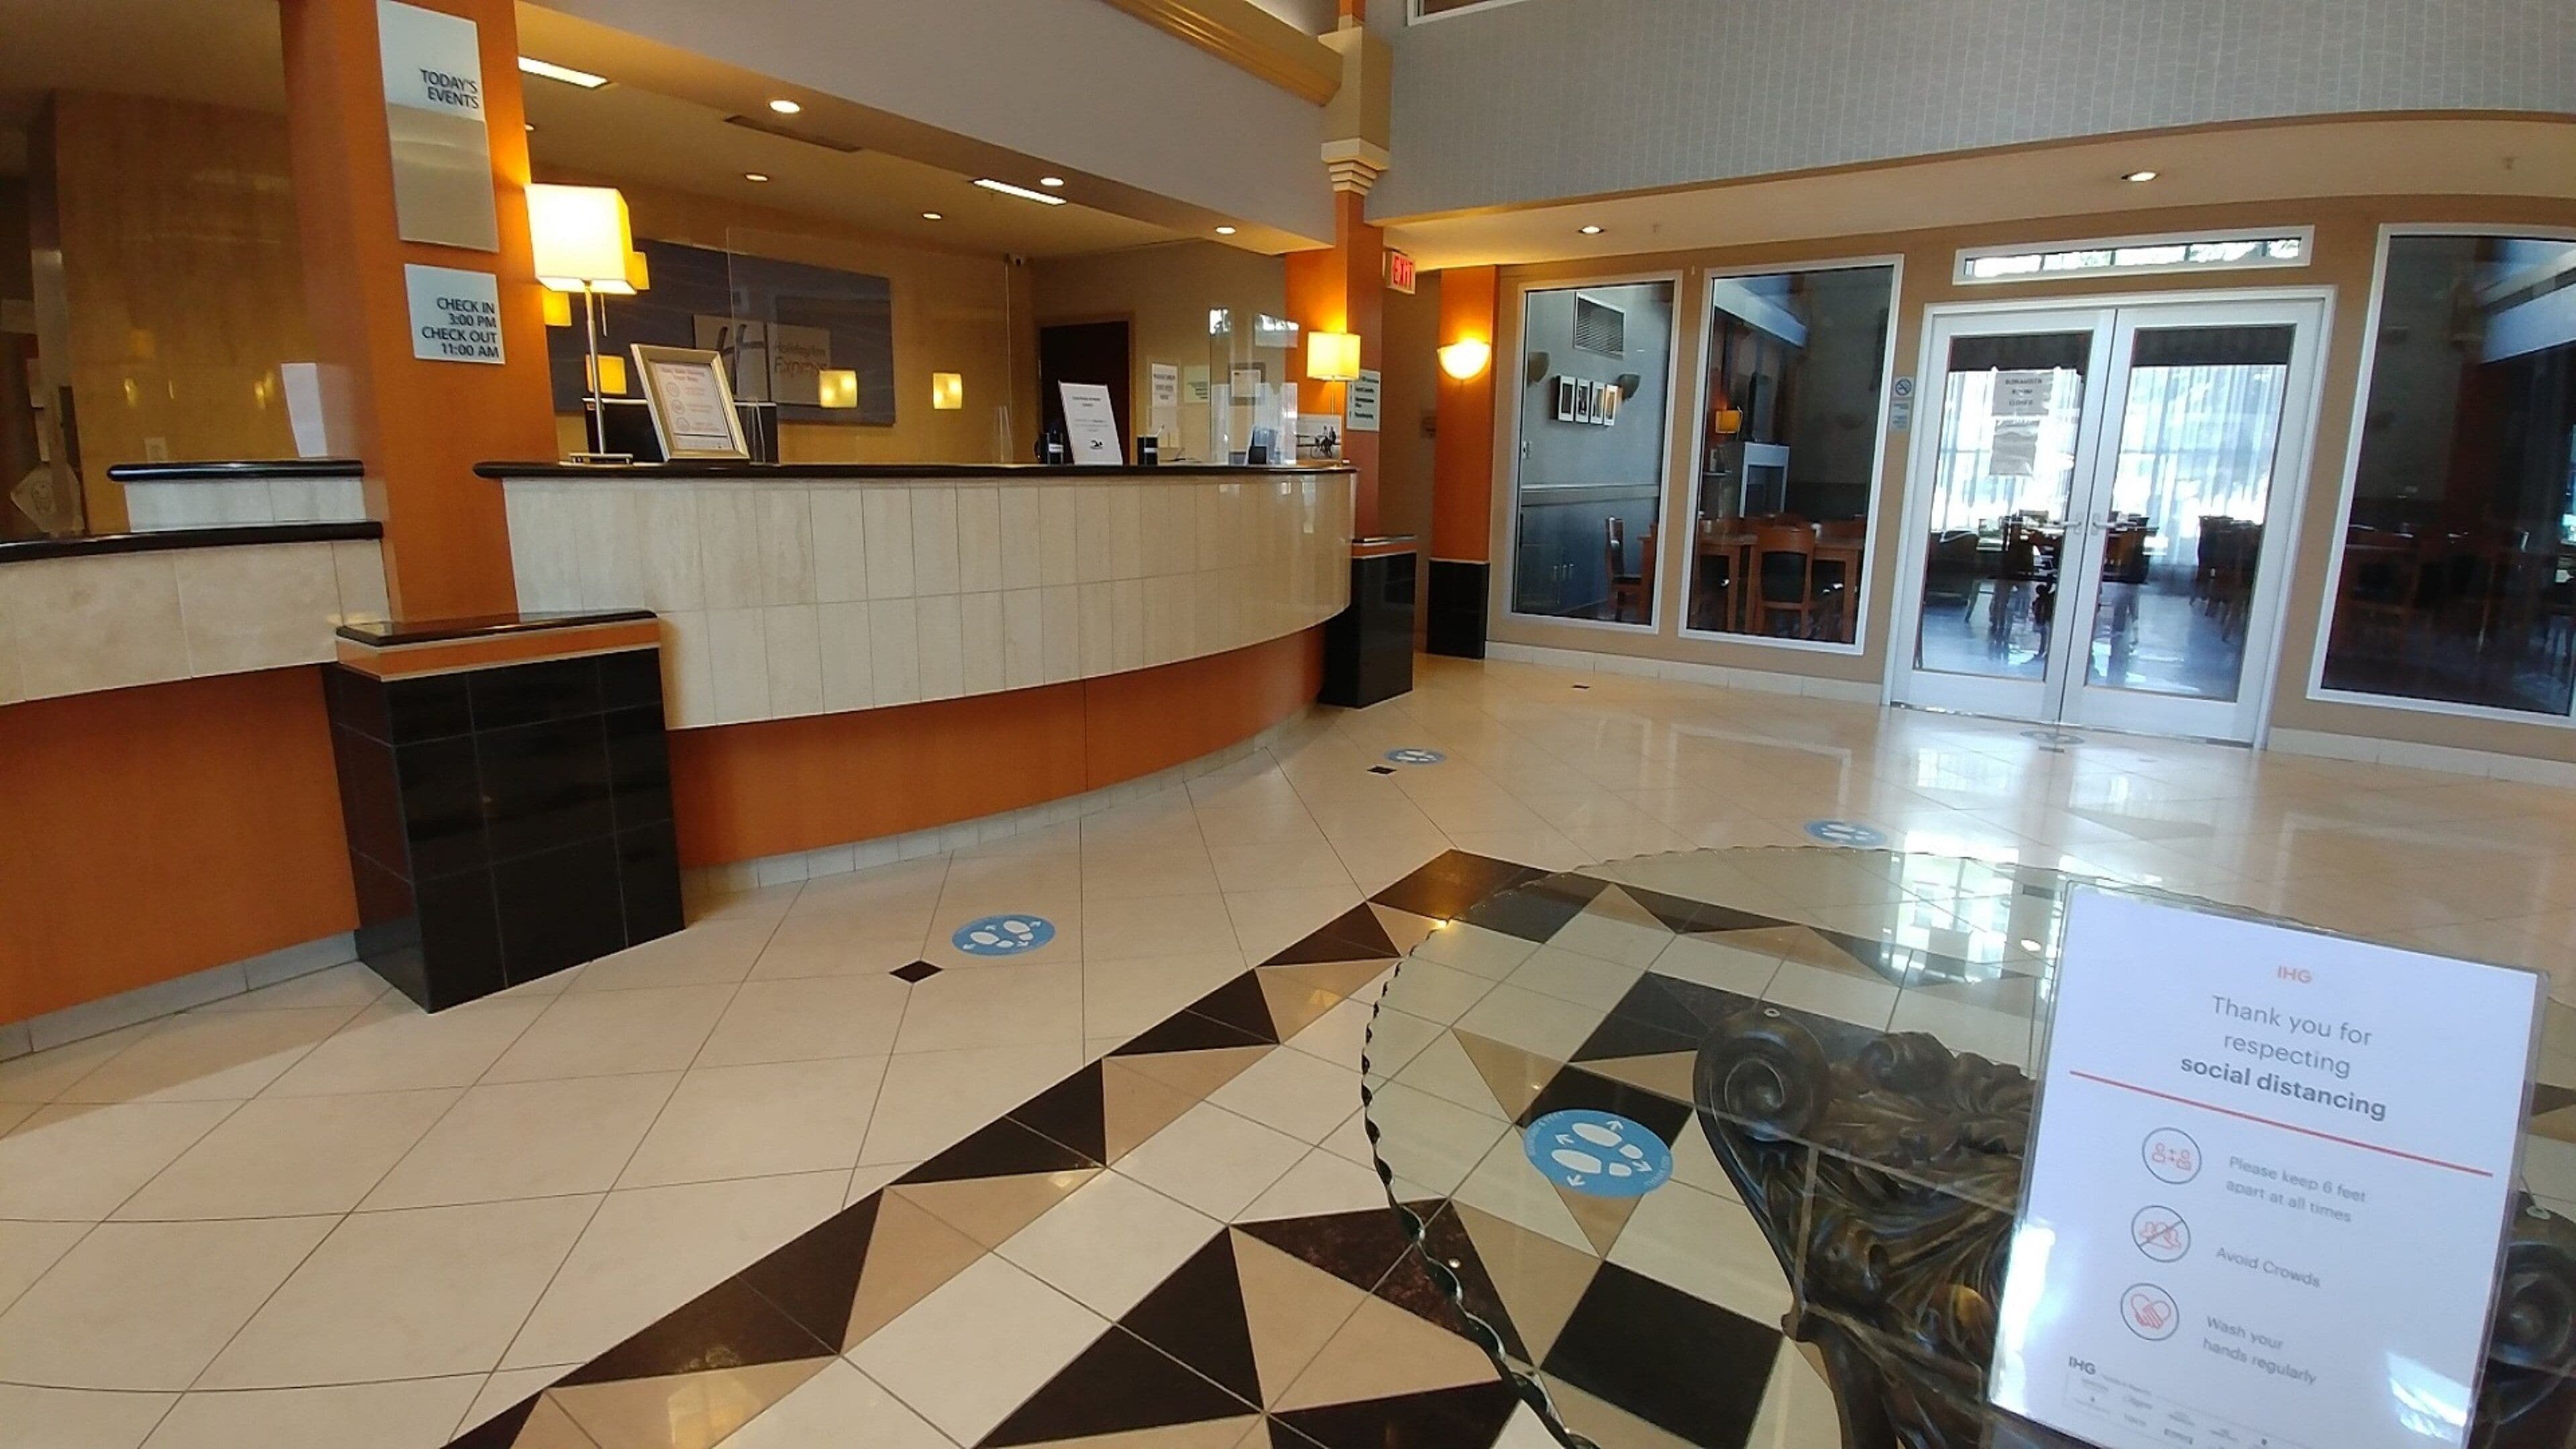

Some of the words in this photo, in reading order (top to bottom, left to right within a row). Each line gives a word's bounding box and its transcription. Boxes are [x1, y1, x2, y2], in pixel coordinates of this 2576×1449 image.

[419, 68, 478, 94] TODAY'S
[428, 87, 479, 109] EVENTS
[1393, 256, 1413, 289] EXIT
[437, 297, 479, 313] CHECK
[482, 302, 495, 314] IN
[449, 313, 474, 326] 3:00
[477, 315, 496, 328] PM
[422, 326, 467, 341] CHECK
[470, 330, 497, 343] OUT
[441, 343, 474, 356] 11:00
[478, 345, 499, 358] AM
[2277, 965, 2313, 983] IHG
[2212, 995, 2281, 1027] Thank
[2289, 1016, 2331, 1037] you
[2340, 1022, 2373, 1046] for
[2224, 1034, 2350, 1079] respecting
[2181, 1057, 2250, 1086] social
[2257, 1073, 2385, 1122] distancing
[2229, 1156, 2277, 1180] Please
[2282, 1170, 2318, 1191] keep
[2322, 1181, 2332, 1194] 6
[2337, 1183, 2366, 1203] feet
[2226, 1181, 2265, 1199] apart
[2269, 1193, 2284, 1205] at
[2288, 1197, 2306, 1210] all
[2310, 1201, 2351, 1222] times
[2216, 1246, 2259, 1269] Avoid
[2263, 1260, 2320, 1288] Crowds
[2206, 1316, 2246, 1338] Wash
[2251, 1332, 2283, 1350] your
[2069, 1356, 2096, 1375] IHG
[2203, 1337, 2247, 1363] hands
[2252, 1356, 2316, 1385] regularly
